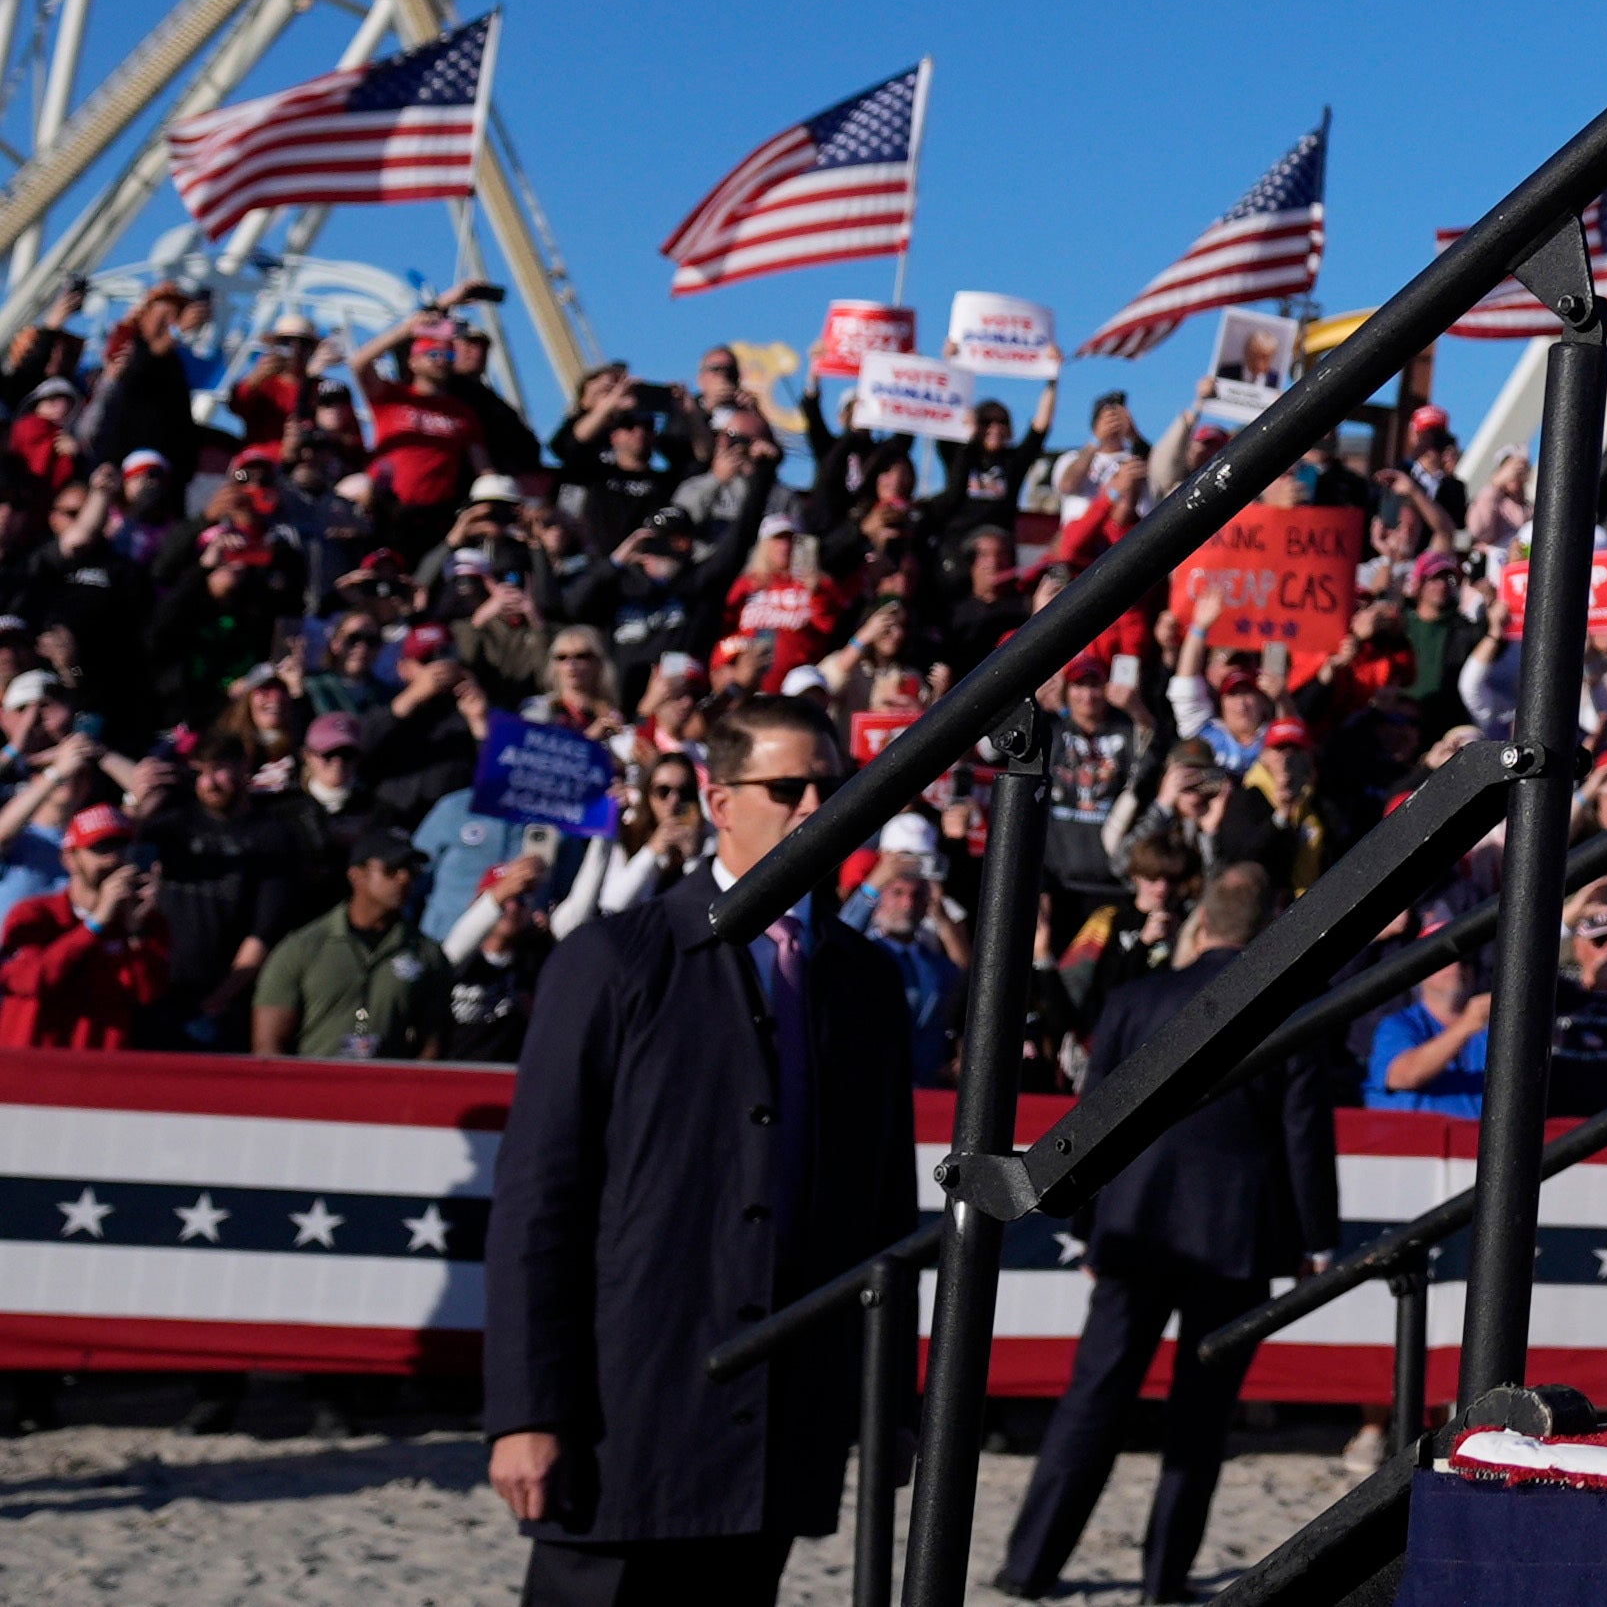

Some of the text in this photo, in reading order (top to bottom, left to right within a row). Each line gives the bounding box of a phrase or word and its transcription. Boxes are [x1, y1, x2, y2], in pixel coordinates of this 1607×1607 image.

[981, 314, 1033, 330] VOTE
[963, 329, 1049, 347] DONALD
[970, 346, 1039, 363] TRUMP
[893, 367, 948, 388] VOTE
[871, 382, 962, 407] DONALD
[879, 401, 953, 421] TRUMP
[523, 729, 590, 759] MAKE
[498, 745, 607, 785] AMERICA
